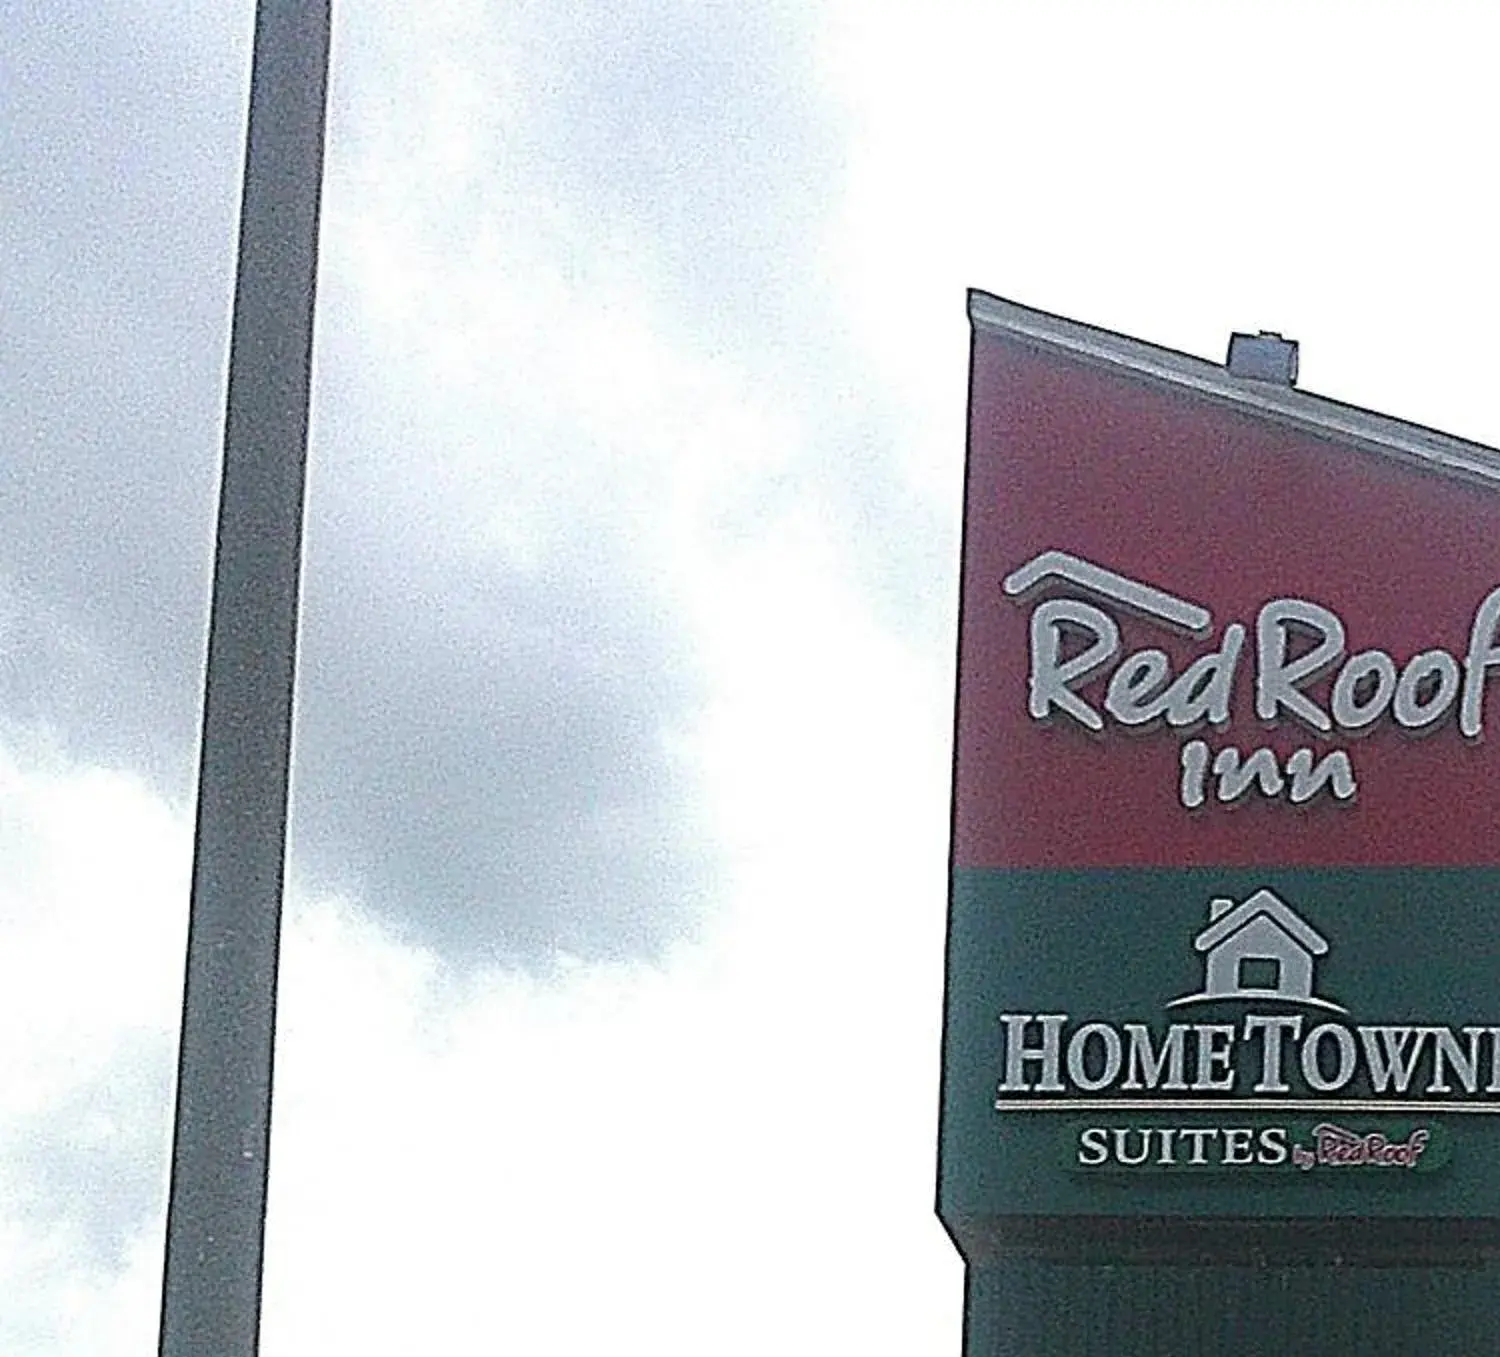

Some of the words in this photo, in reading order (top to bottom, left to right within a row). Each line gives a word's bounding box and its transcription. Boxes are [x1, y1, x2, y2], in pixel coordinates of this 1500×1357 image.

[1029, 598, 1246, 730] Red
[1180, 739, 1358, 808] Inn
[1078, 1127, 1289, 1167] SUITES
[1317, 1132, 1366, 1166] Red
[1363, 1129, 1431, 1168] Roof
